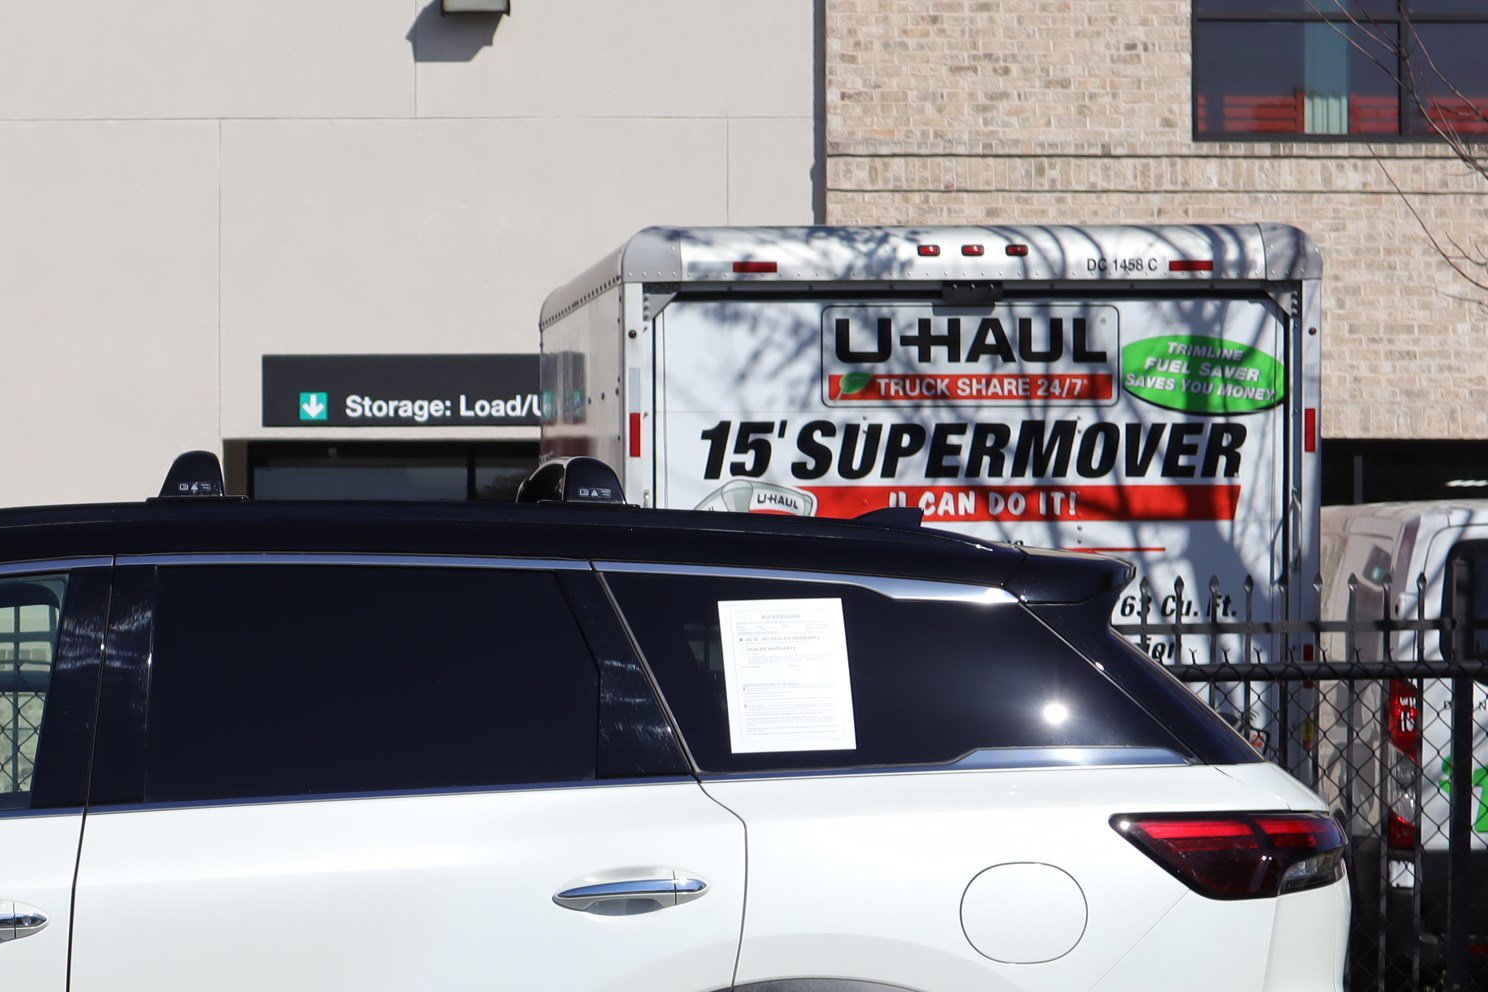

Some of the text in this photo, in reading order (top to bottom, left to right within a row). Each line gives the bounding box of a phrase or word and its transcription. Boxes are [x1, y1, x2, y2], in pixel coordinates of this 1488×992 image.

[1087, 257, 1158, 272] DC 1458 C
[835, 317, 1107, 363] U-HAUL
[1167, 341, 1244, 361] TRIMLINE
[1144, 357, 1261, 382] FUEL SAVER
[876, 378, 1083, 397] TRUCK SHARE 24/7
[1125, 373, 1277, 402] SAVES YOU MONEY
[345, 394, 451, 422] Storage:
[701, 419, 1248, 480] 15' SUPERMOVER
[756, 492, 799, 509] U-HAUL
[918, 490, 975, 516] CAN
[988, 490, 1026, 516] DO
[1039, 490, 1077, 516] IT!
